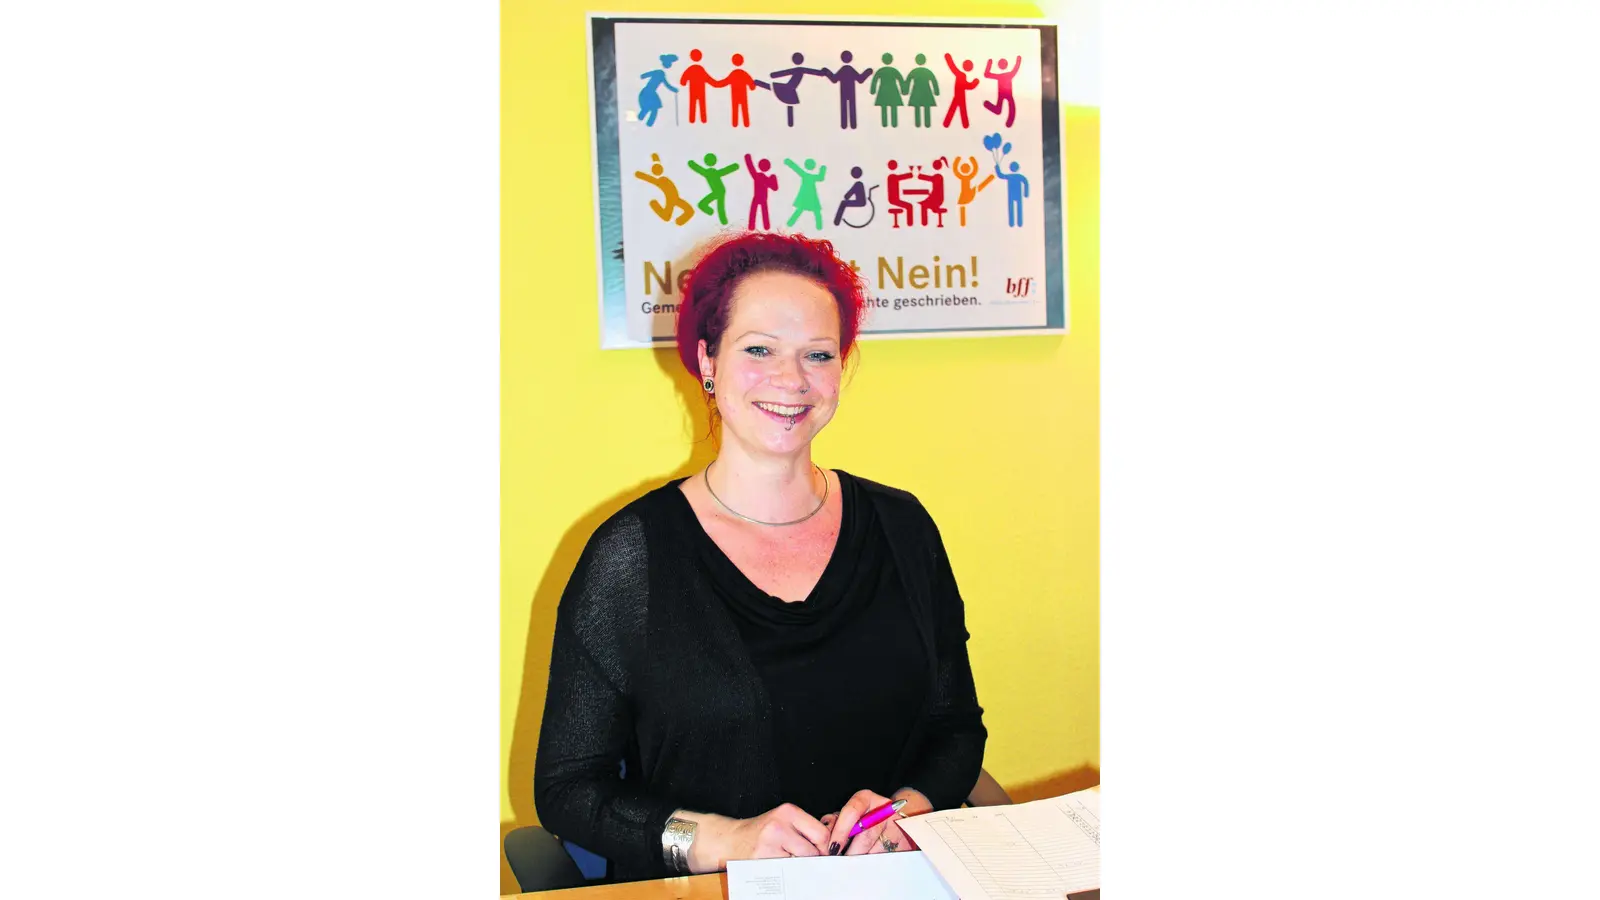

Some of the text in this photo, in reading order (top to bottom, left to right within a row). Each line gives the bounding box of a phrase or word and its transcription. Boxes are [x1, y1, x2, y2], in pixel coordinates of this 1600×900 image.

[644, 255, 979, 295] Ne Nein!
[641, 301, 681, 314] Geme
[865, 296, 889, 308] hte
[893, 294, 982, 310] geschrieben.
